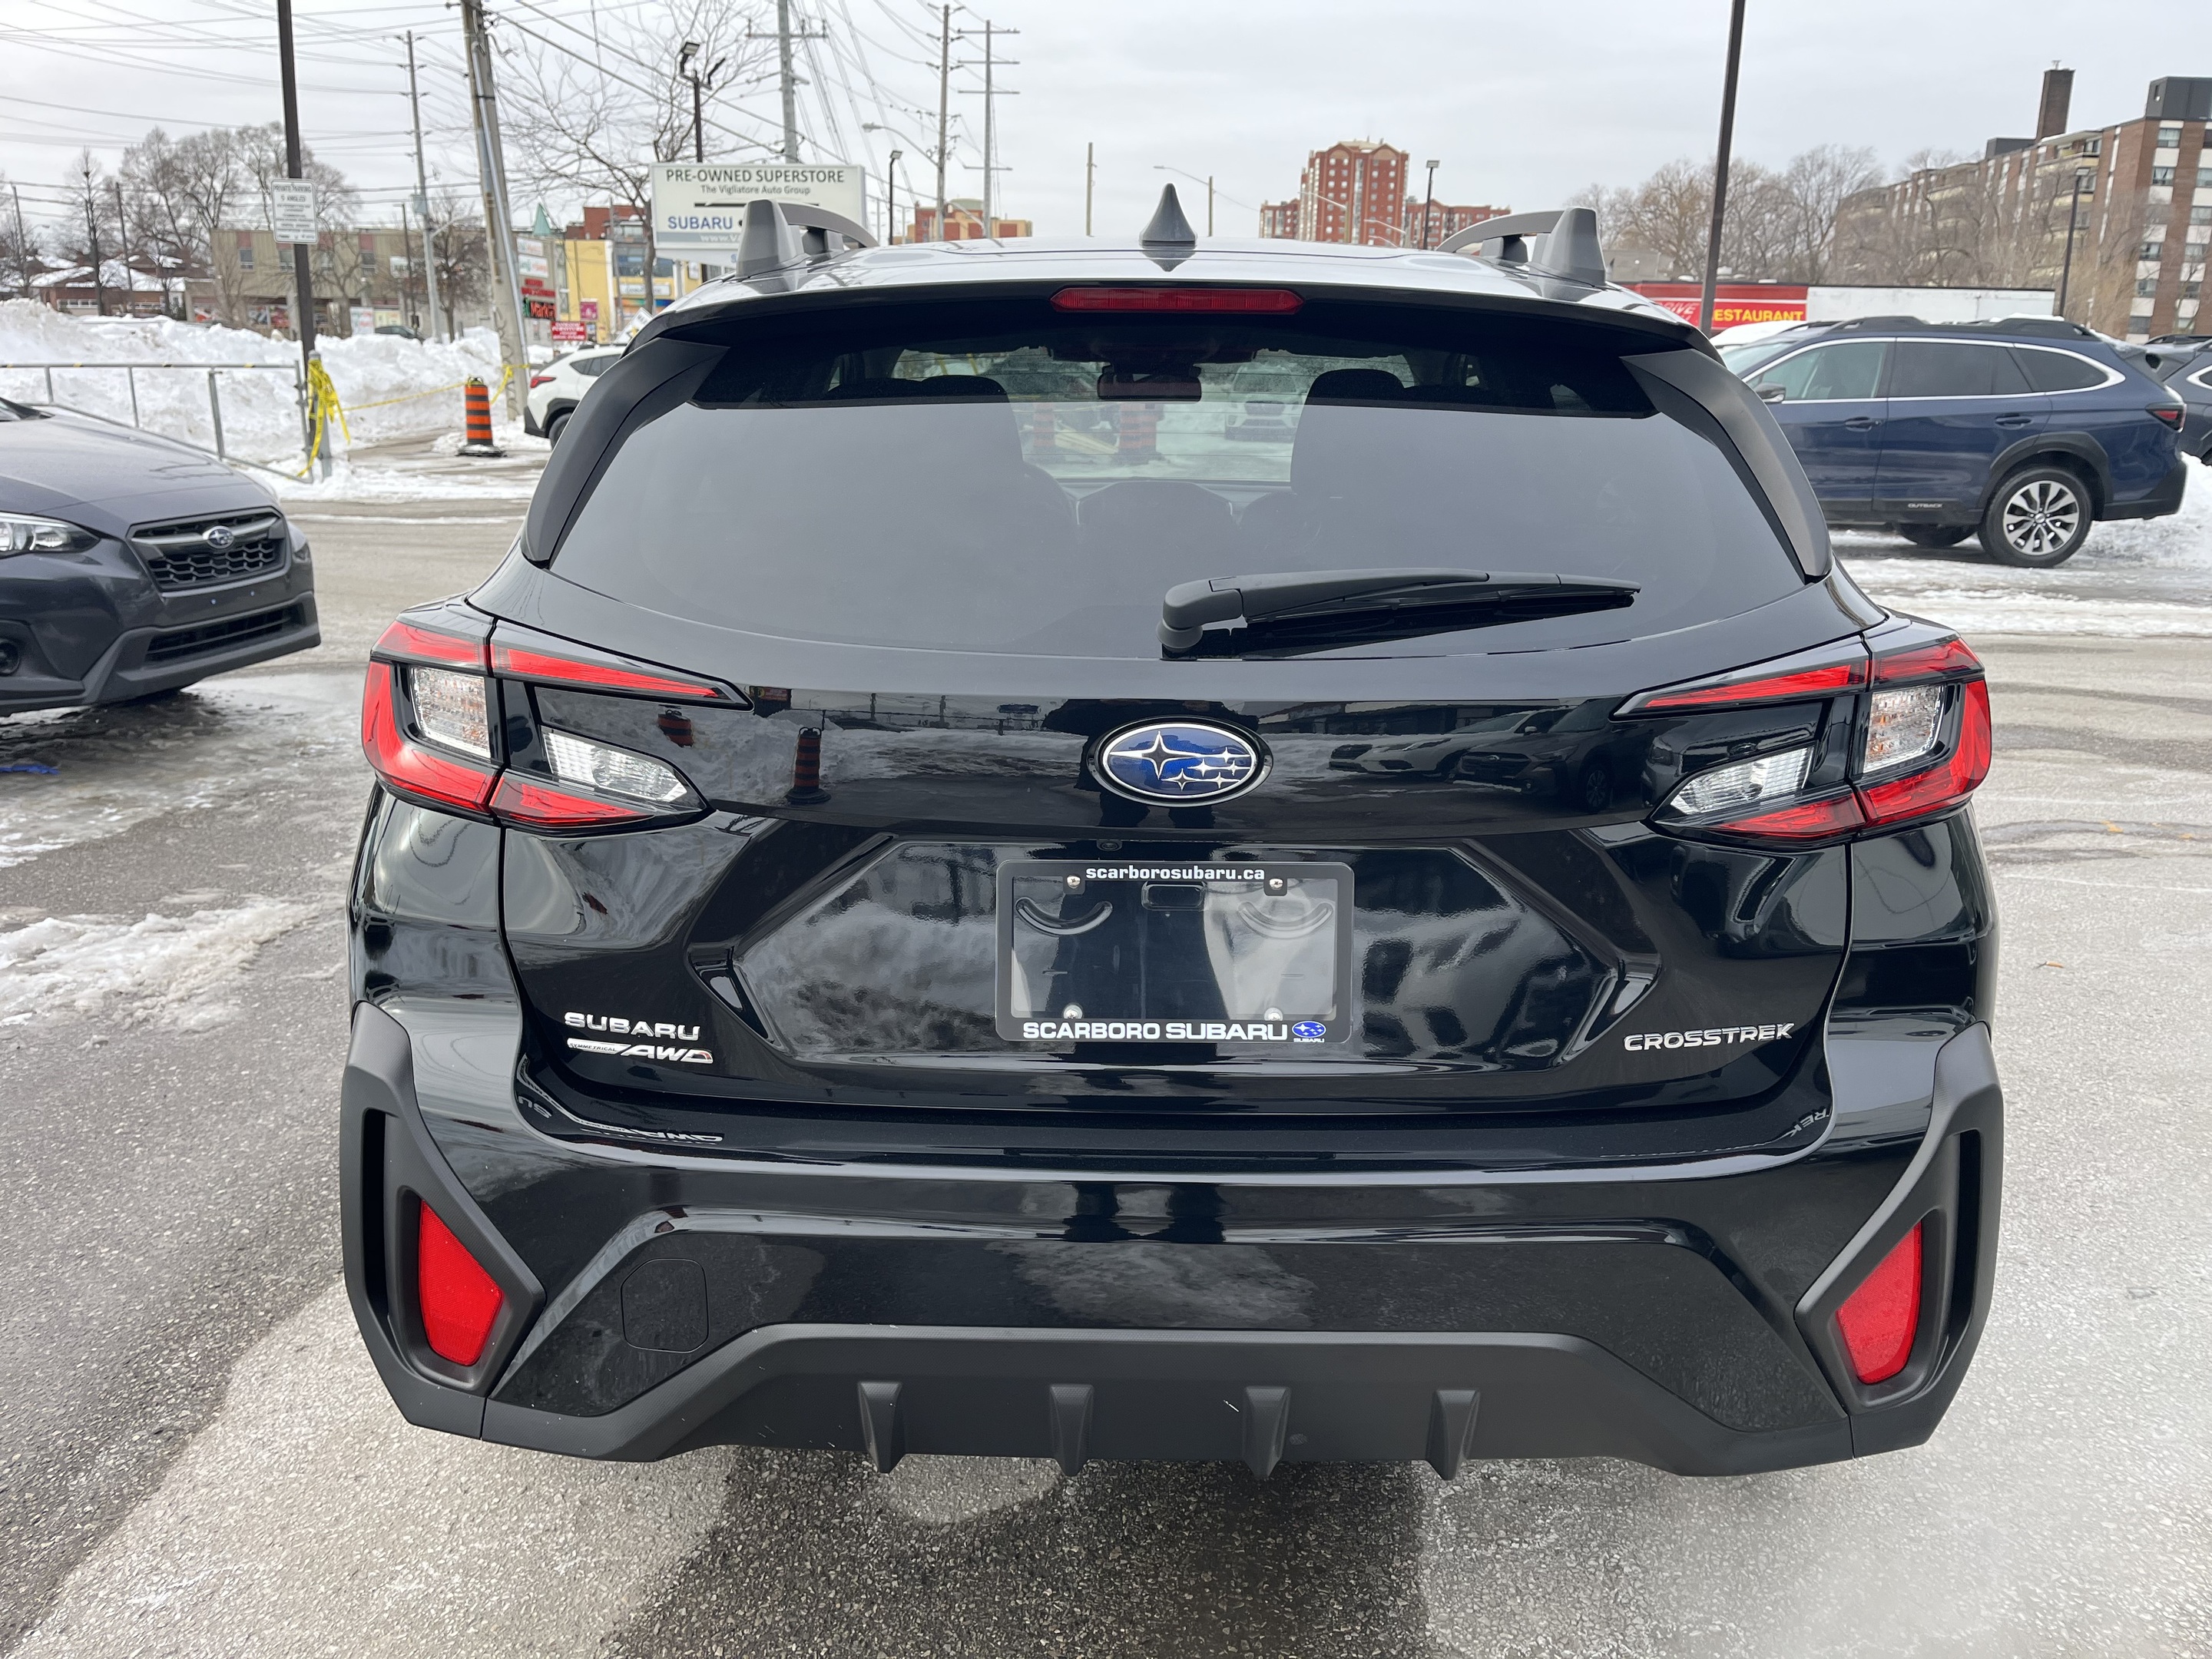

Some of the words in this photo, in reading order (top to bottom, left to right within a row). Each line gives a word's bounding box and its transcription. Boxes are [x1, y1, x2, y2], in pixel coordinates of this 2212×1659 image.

[666, 170, 752, 183] PRE-OWNED
[757, 170, 844, 184] SUPERSTORE
[700, 185, 717, 194] The
[762, 186, 782, 194] Auto
[783, 186, 811, 195] Group
[667, 216, 733, 230] SUBARU
[1714, 309, 1803, 322] ESTAURANT
[1085, 865, 1266, 881] scarborosubaru.ca
[564, 1012, 700, 1041] SUBARU
[1022, 1022, 1161, 1040] SCARBORO
[1165, 1022, 1288, 1041] SUBARU
[1623, 1022, 1795, 1051] CROSSTREK
[569, 1042, 618, 1052] SYMMETRICAL
[621, 1045, 714, 1064] AWD
